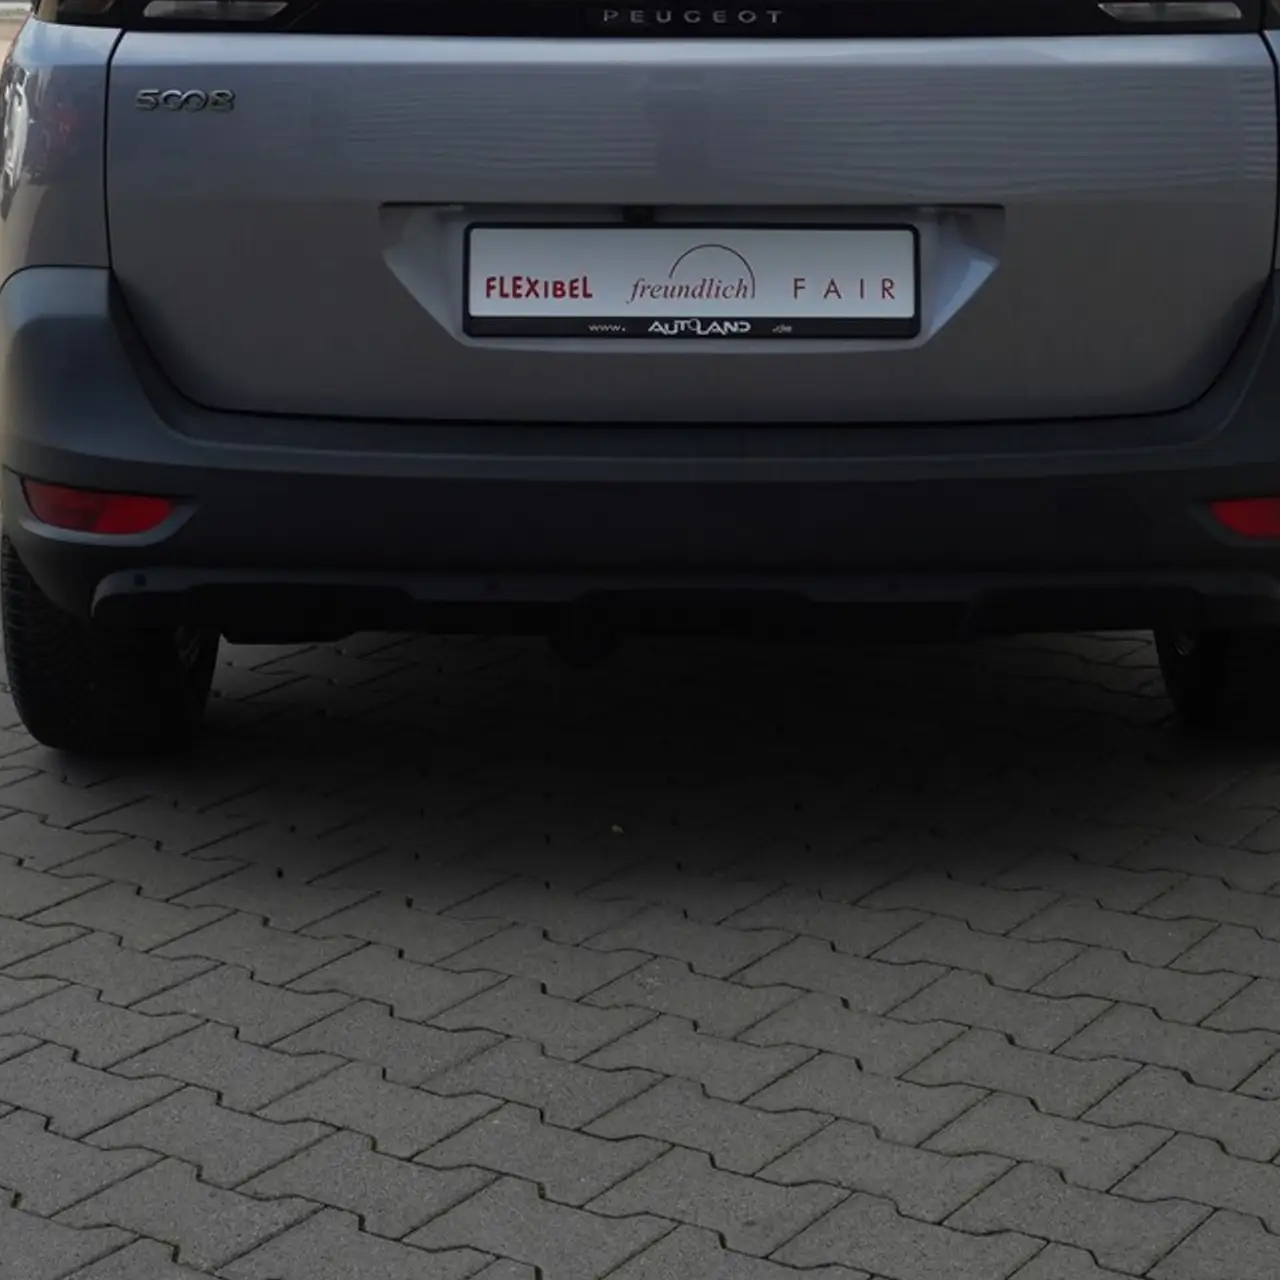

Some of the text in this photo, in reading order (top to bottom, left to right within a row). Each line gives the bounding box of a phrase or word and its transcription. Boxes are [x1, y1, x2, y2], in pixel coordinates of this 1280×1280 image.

[604, 9, 784, 23] PEUGEOT
[136, 89, 235, 111] 5008
[486, 276, 895, 304] FLEXIBEL freundlich FAIR
